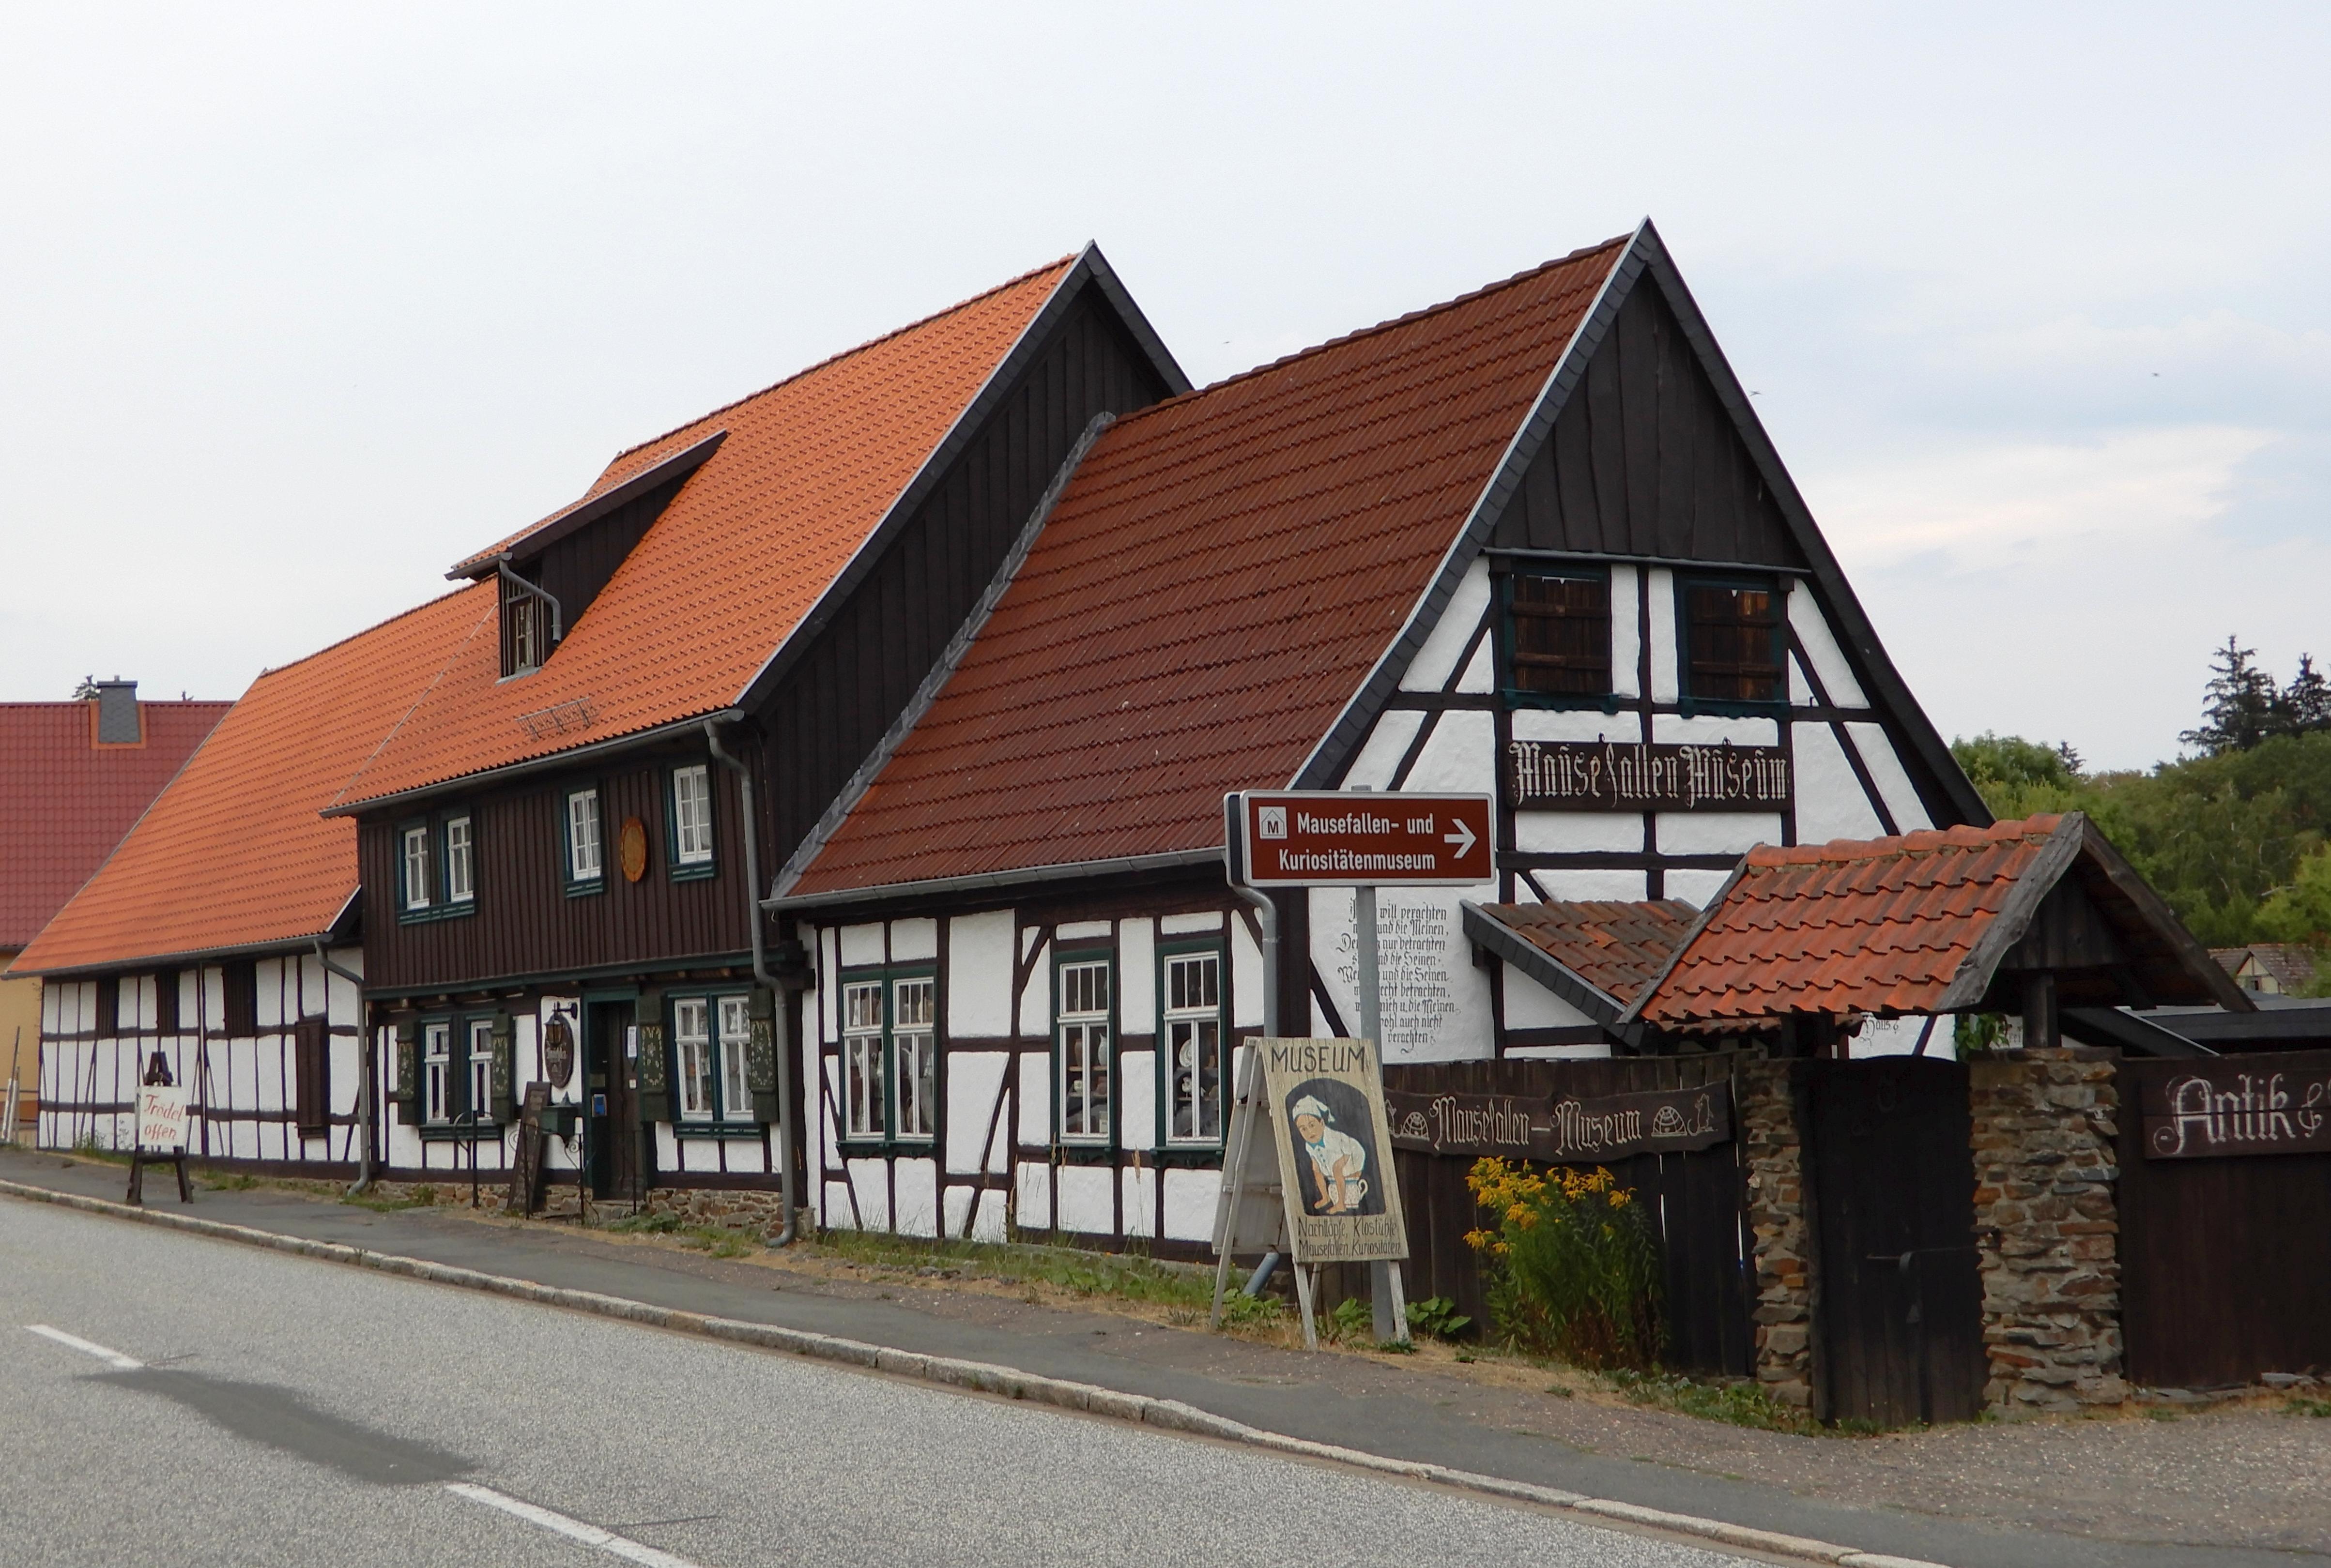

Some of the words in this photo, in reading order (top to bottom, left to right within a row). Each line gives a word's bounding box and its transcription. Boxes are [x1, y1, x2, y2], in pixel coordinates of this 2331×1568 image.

[1267, 821, 1279, 834] M
[1297, 812, 1399, 834] Mausefallen-
[1407, 813, 1434, 834] und
[1279, 849, 1435, 870] Kuriositätenmuseum
[1380, 899, 1396, 919] will
[1377, 921, 1393, 934] und
[1396, 921, 1408, 934] die
[1336, 932, 1358, 953] De
[1382, 939, 1396, 950] nur
[1398, 935, 1445, 952] betrachten
[1379, 950, 1388, 964] nd
[1390, 951, 1402, 965] die
[1383, 966, 1398, 981] und
[1401, 967, 1413, 981] die
[1380, 982, 1397, 998] echt
[1409, 999, 1421, 1012] die
[1400, 1015, 1419, 1030] auch
[1422, 1014, 1442, 1030] nicht
[1272, 1046, 1365, 1073] MUSEUM
[144, 1094, 184, 1121] Trödel
[2154, 1073, 2296, 1155] Antik
[2298, 1082, 2322, 1138] &
[144, 1124, 176, 1140] offen
